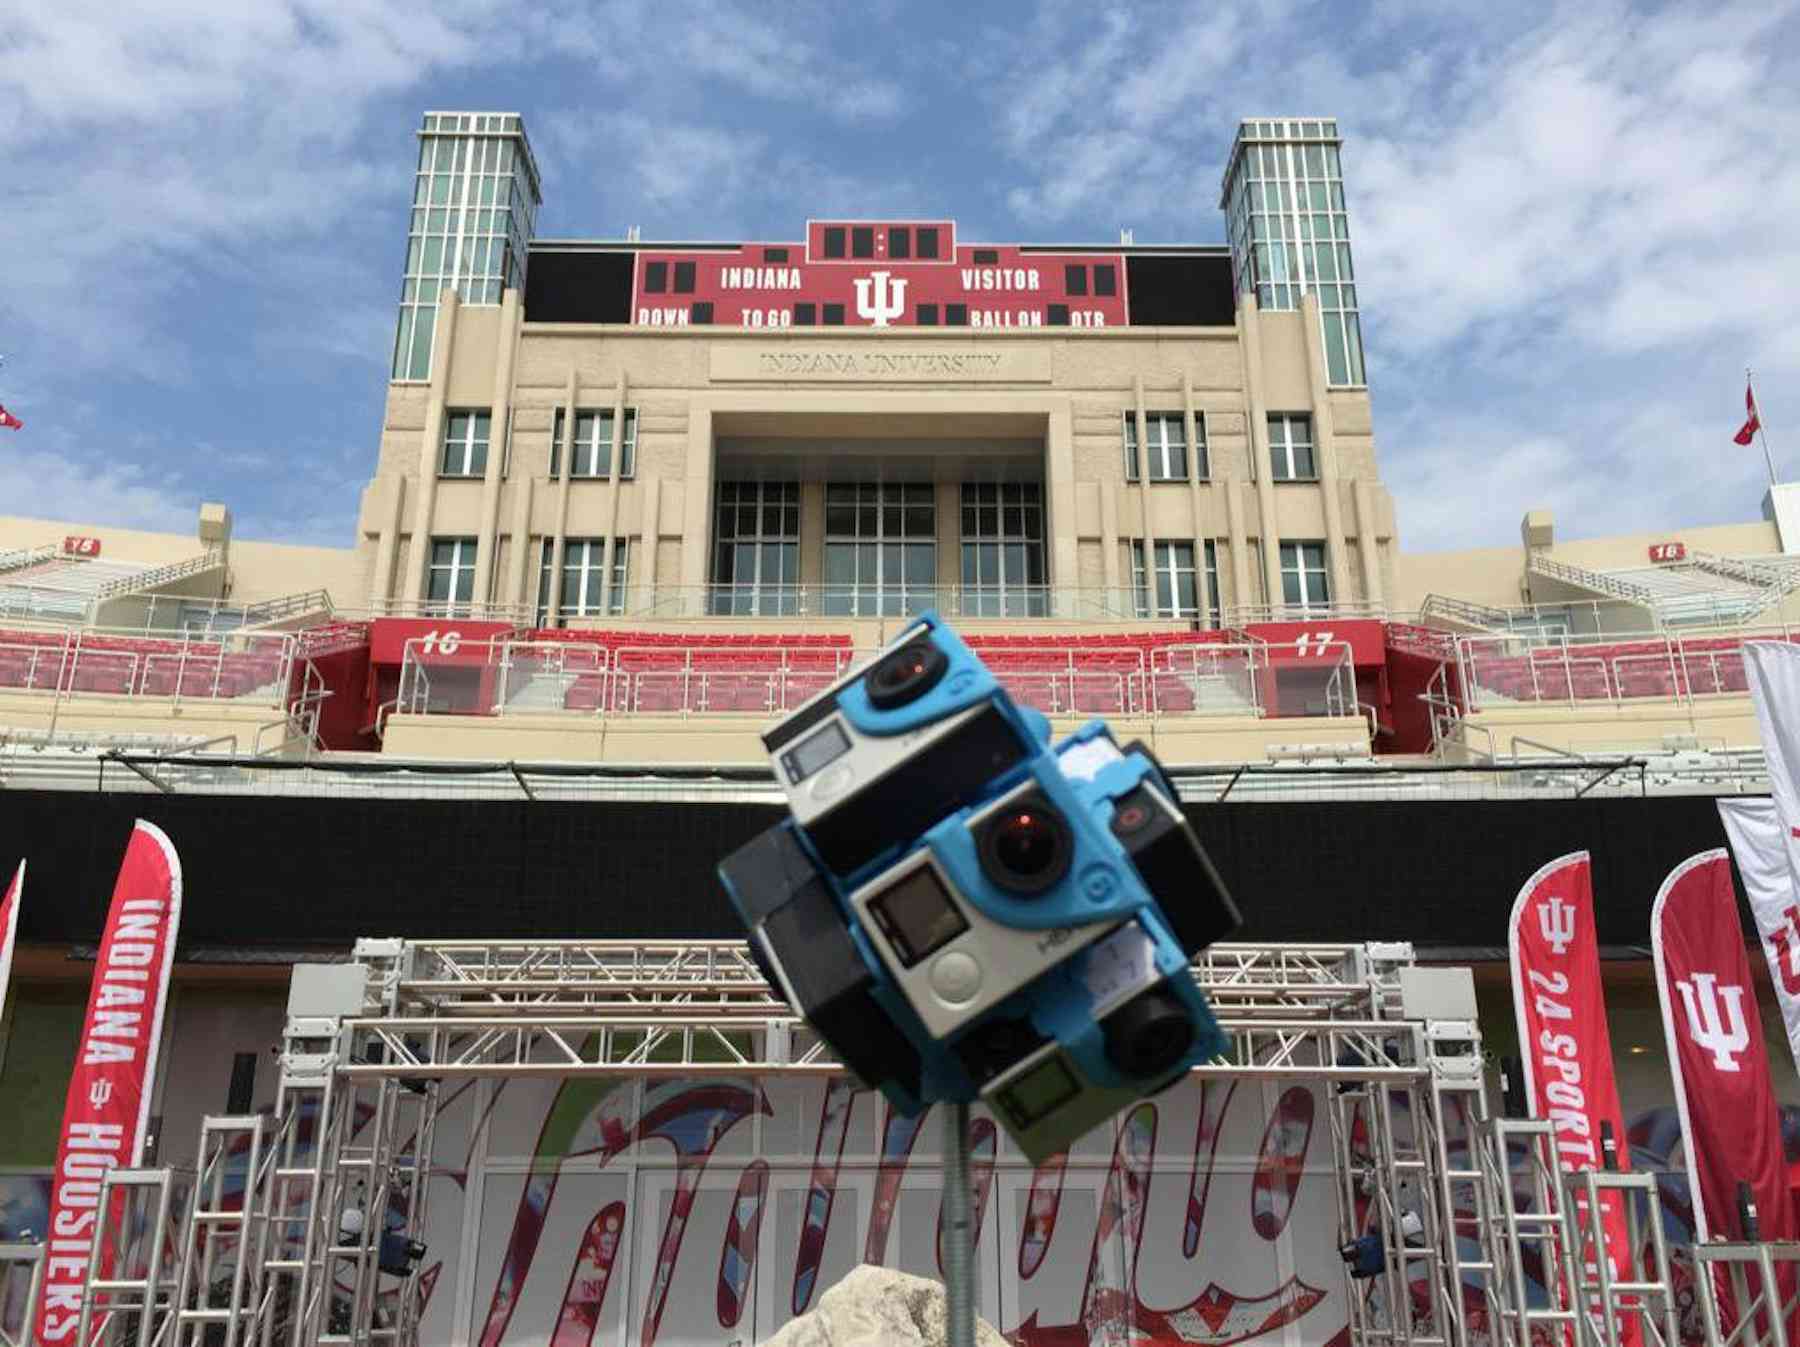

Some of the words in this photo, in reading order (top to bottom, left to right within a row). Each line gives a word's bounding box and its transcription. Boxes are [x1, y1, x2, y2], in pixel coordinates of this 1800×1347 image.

[720, 267, 801, 290] INDIANA
[961, 269, 1040, 291] VISITOR
[638, 308, 690, 327] DOWN
[1017, 310, 1042, 328] ON
[760, 353, 858, 374] INDIANA
[864, 353, 1001, 374] UNIVERSITY
[423, 630, 461, 655] 16
[1295, 631, 1334, 656] 17
[84, 899, 165, 1065] INDIANA
[1529, 969, 1572, 1020] 24
